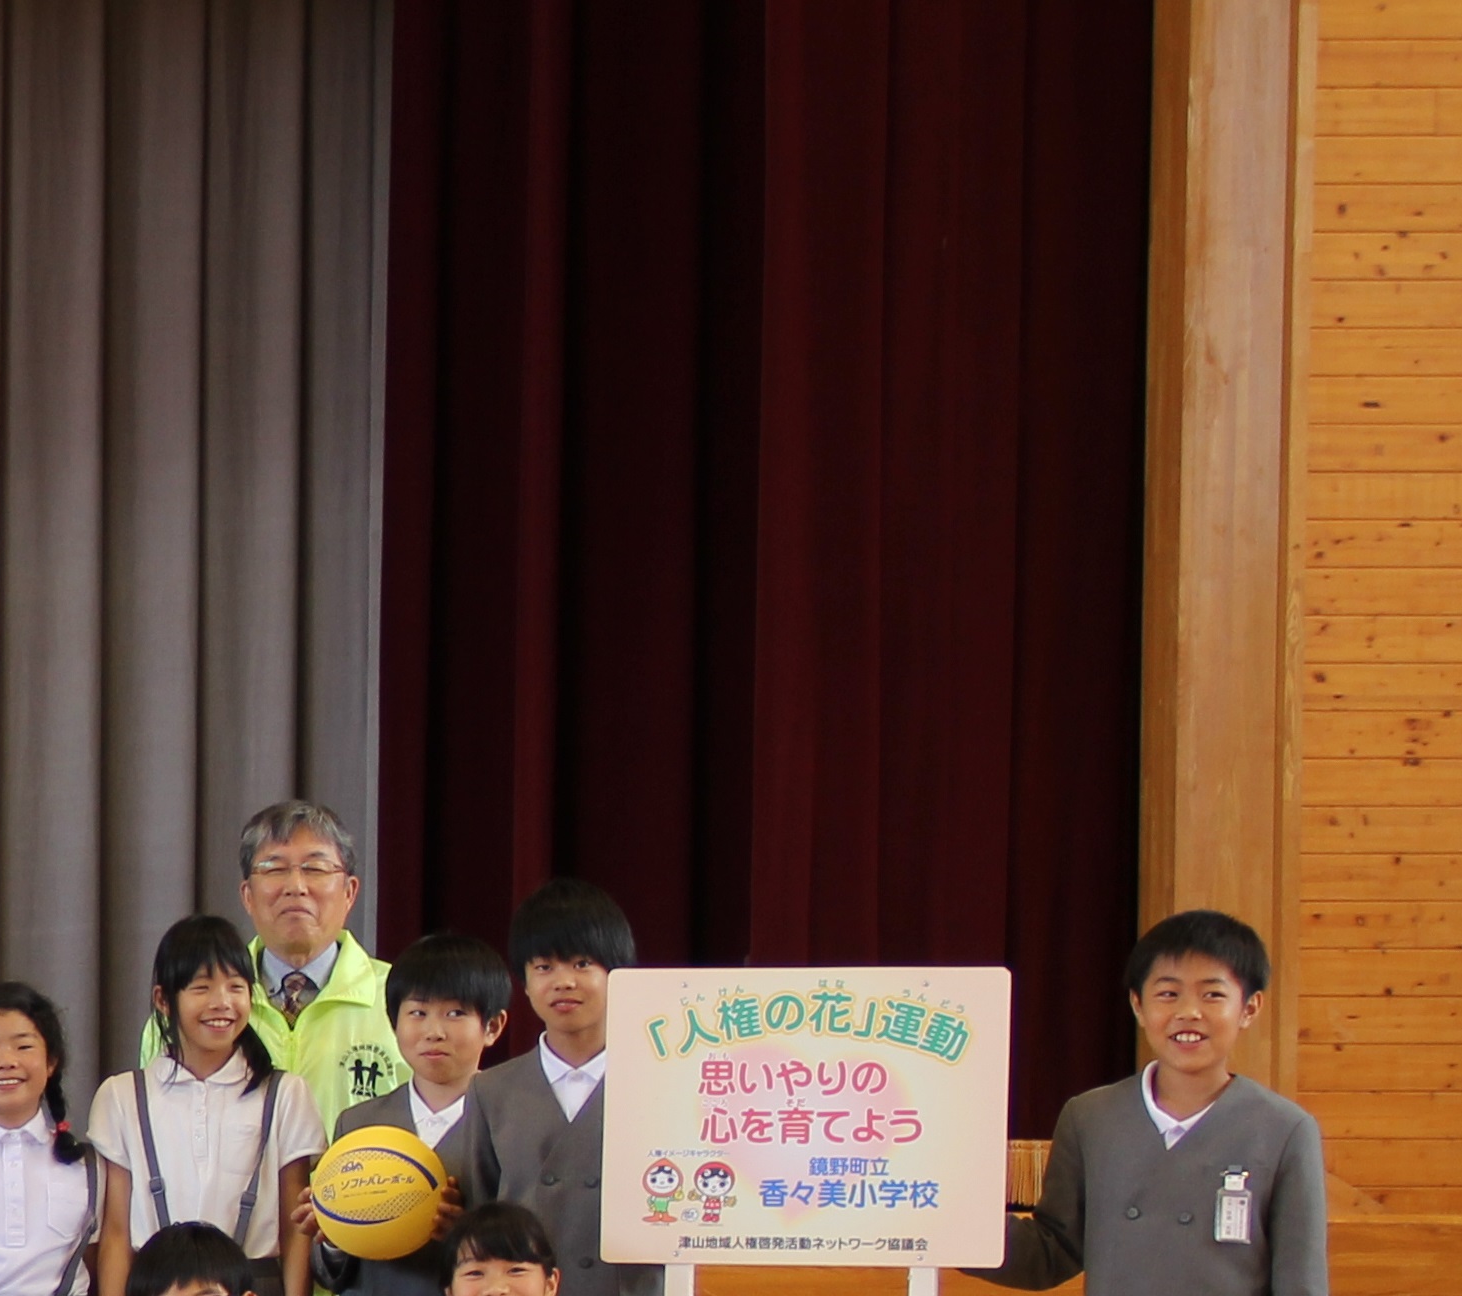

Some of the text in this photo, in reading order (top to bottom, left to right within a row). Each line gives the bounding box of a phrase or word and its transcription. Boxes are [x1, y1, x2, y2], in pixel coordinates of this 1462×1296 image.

[648, 992, 969, 1061] 「人権の花」運動
[698, 1060, 888, 1096] 思いやりの
[700, 1107, 923, 1144] 心を育てよう
[808, 1157, 890, 1176] 鏡野町立
[341, 1174, 415, 1191] ソフトバレーボール
[758, 1179, 940, 1209] 香々美小学校
[678, 1235, 929, 1251] 津山地域人権啓発活動ネットワーク協議会
